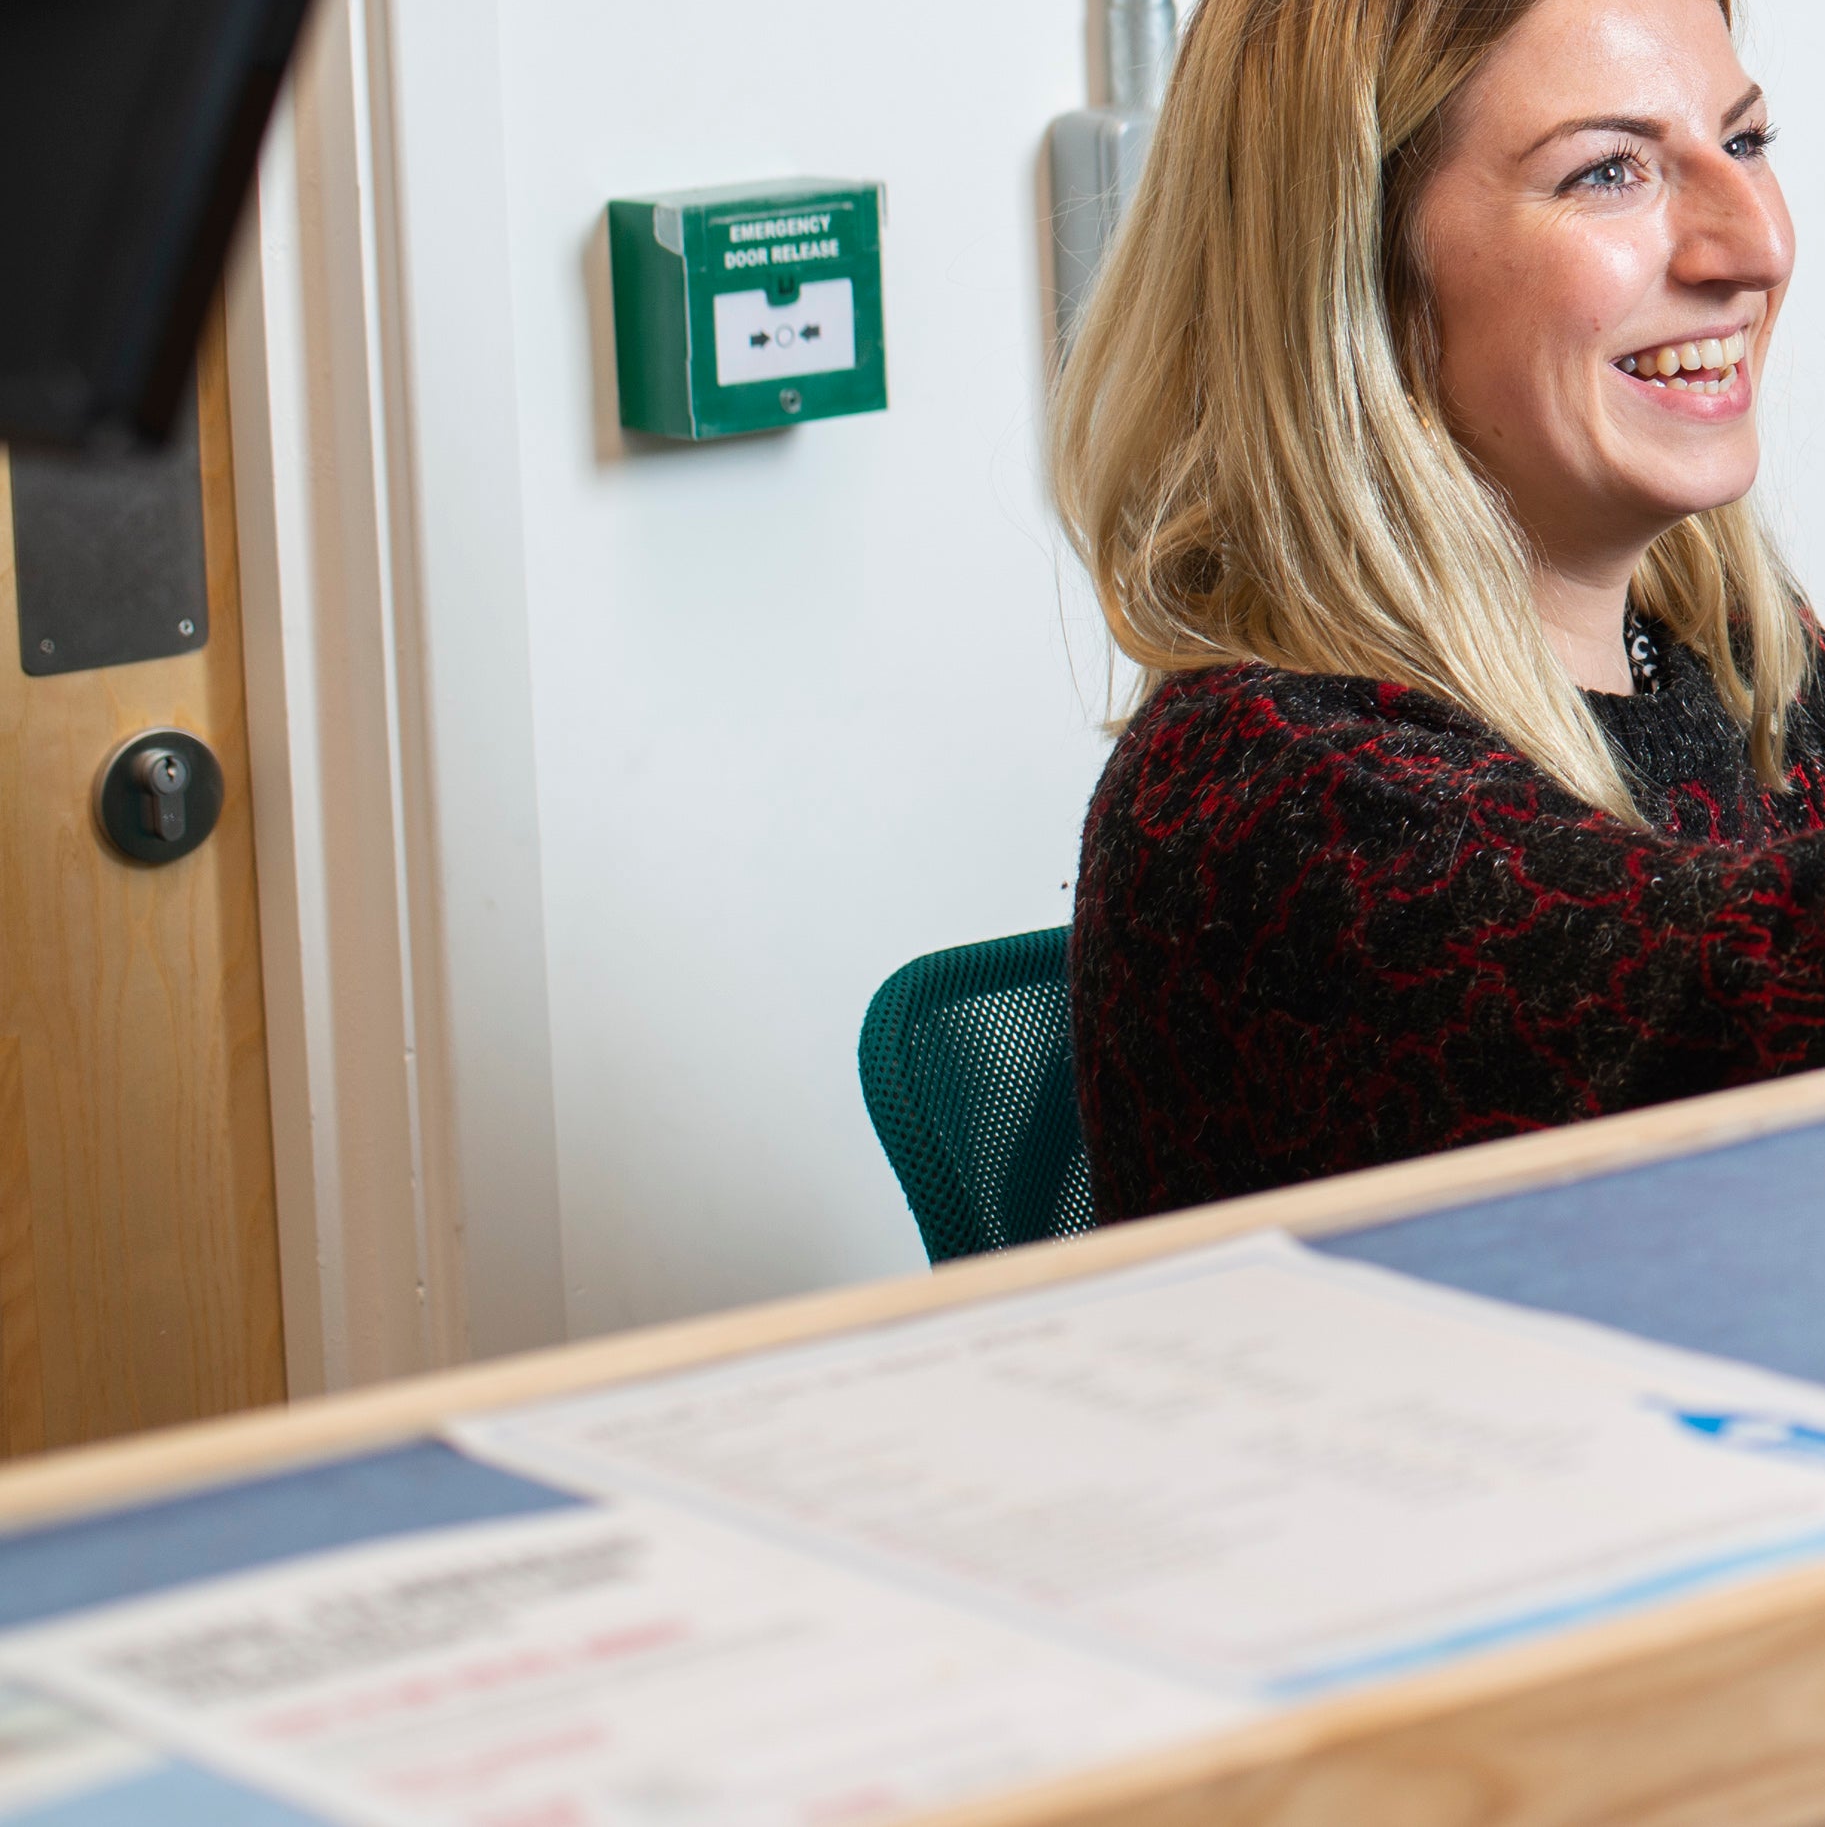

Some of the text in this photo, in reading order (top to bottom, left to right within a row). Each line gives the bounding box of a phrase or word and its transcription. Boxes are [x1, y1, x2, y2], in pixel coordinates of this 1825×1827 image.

[729, 213, 831, 243] EMERGENCY
[724, 238, 839, 270] DOOR RELEASE
